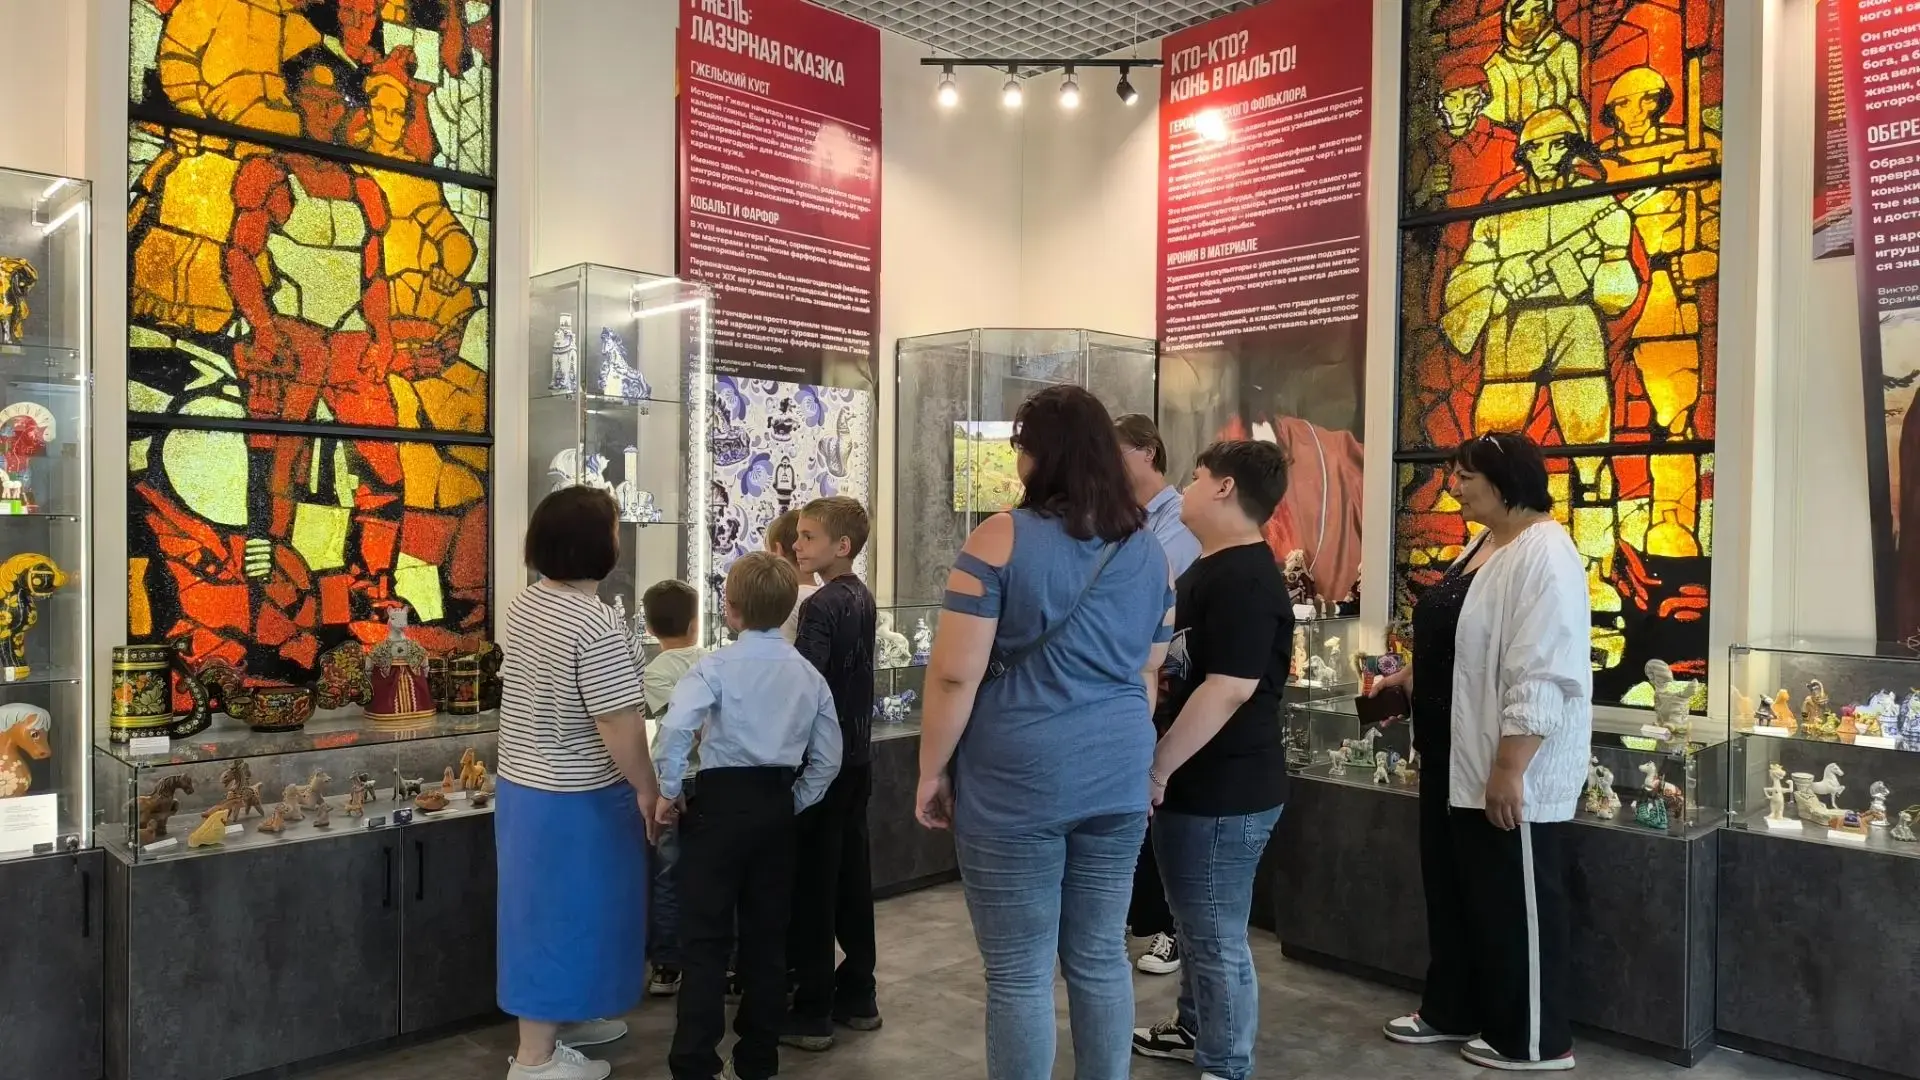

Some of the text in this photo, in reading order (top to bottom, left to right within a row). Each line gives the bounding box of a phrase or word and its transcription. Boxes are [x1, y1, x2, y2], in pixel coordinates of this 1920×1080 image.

[1860, 10, 1891, 22] ного
[1860, 32, 1880, 42] Он
[690, 15, 845, 86] ЛАЗУРНАЯ СКАЗКА
[1172, 30, 1249, 76] КТО-КТО?
[1862, 57, 1898, 70] бога,
[690, 59, 770, 96] ГЖЕЛЬСКИЙ КУСТ
[1170, 45, 1297, 104] КОНЬ В ПАЛЬТО!
[1864, 72, 1889, 84] ход
[690, 85, 723, 101] История
[1865, 82, 1914, 97] жизни,
[1250, 84, 1306, 112] ФОЛЬКЛОРА
[1870, 155, 1914, 170] Образ
[690, 194, 779, 225] КОБАЛЬТ И ФАРФОР
[1872, 199, 1900, 210] тые
[1874, 234, 1884, 244] В
[1167, 237, 1257, 265] ИРОНИЯ В МАТЕРИАЛЕ
[1876, 263, 1892, 272] ся
[1878, 284, 1918, 296] Виктор
